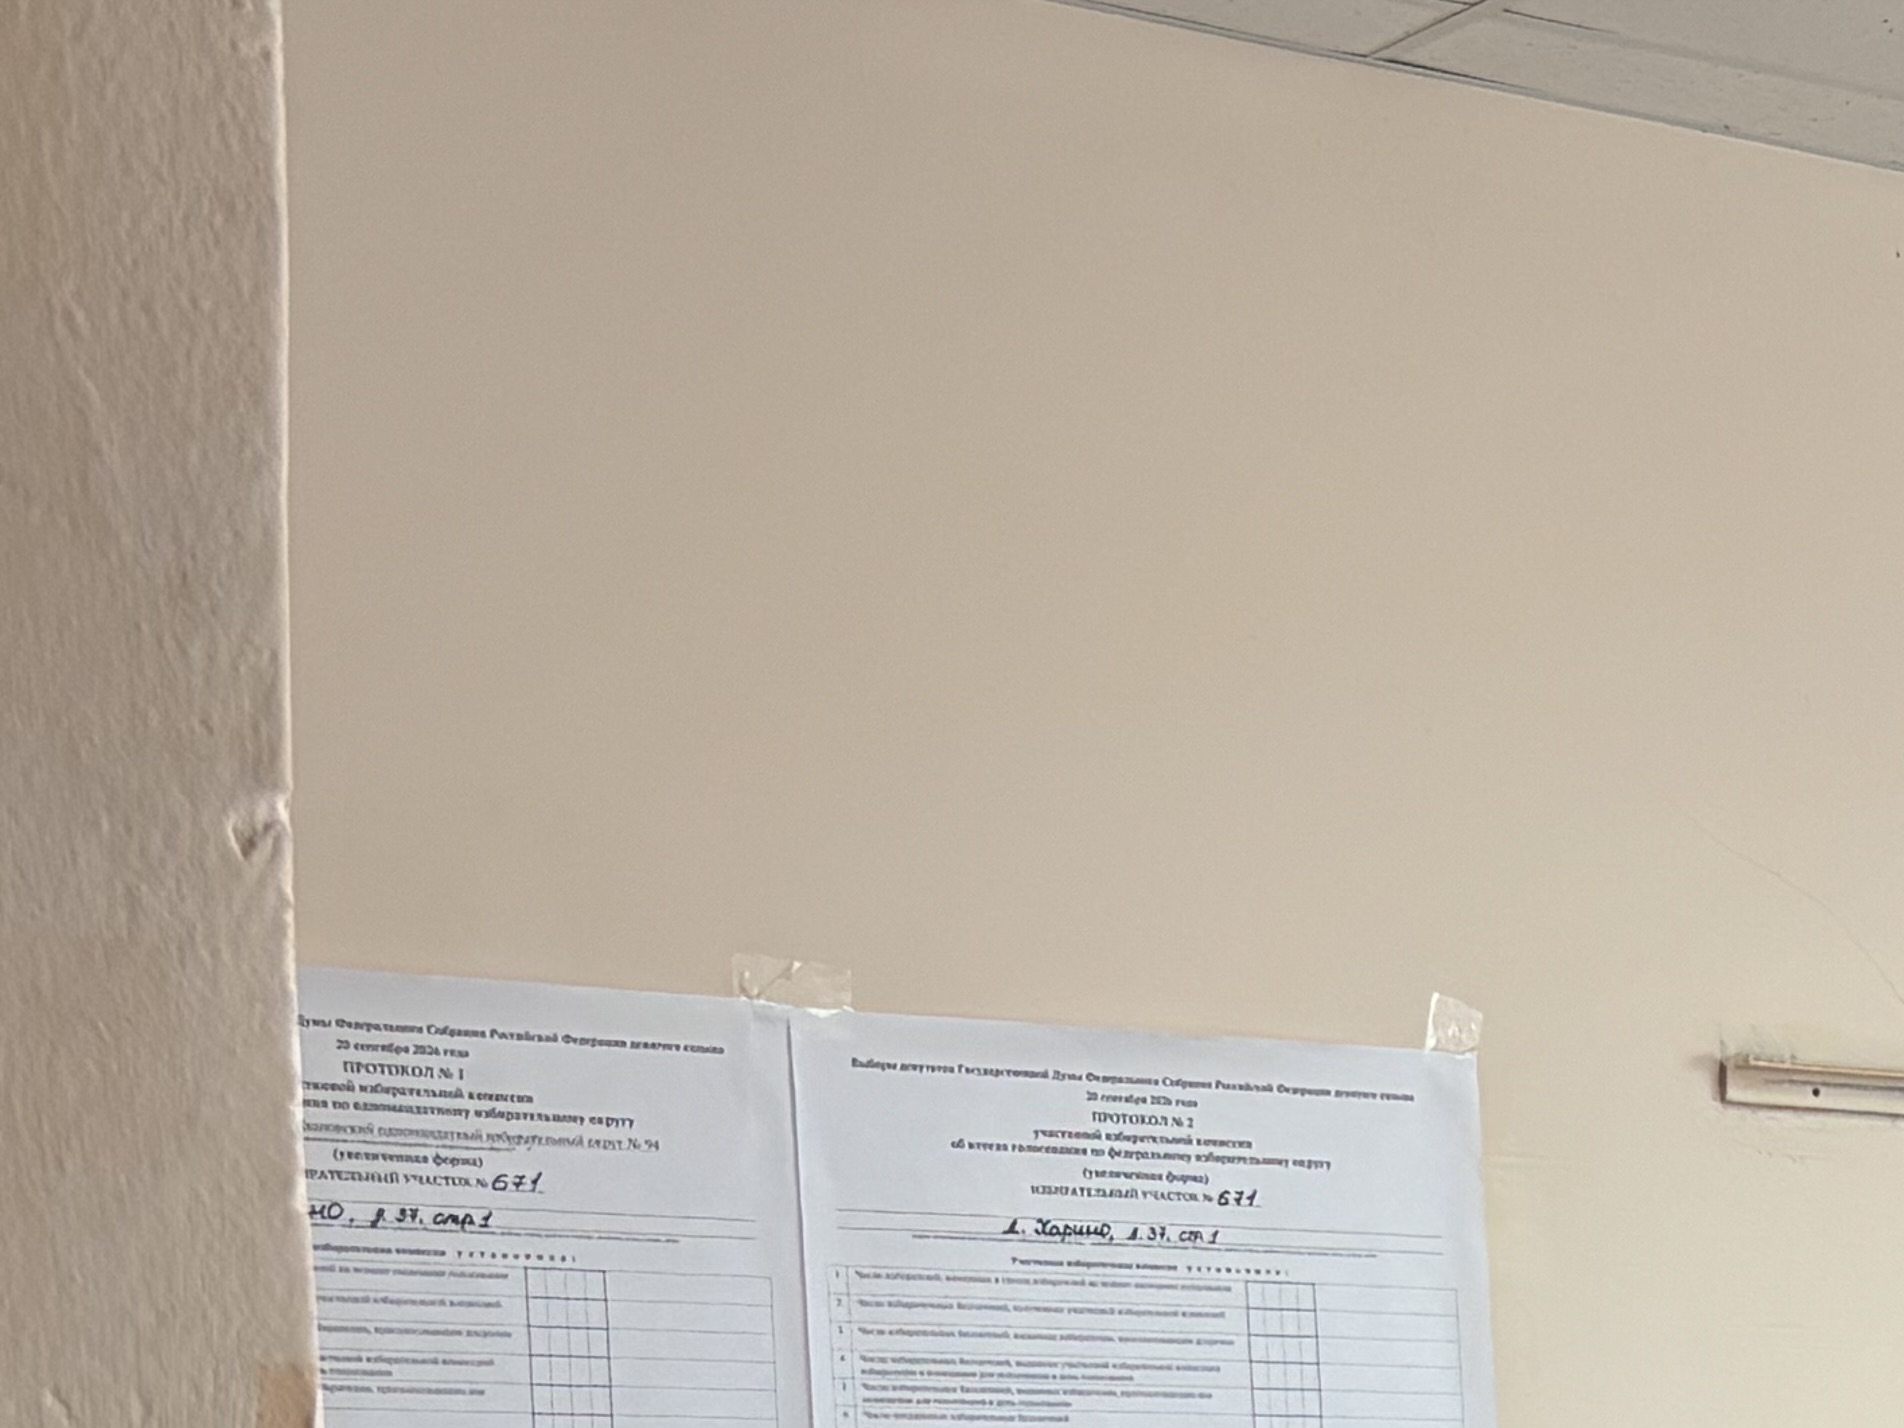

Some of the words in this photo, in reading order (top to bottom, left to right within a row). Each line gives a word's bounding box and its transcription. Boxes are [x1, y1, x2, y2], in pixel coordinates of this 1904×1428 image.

[343, 1061, 434, 1079] ПРОТОКОЛ
[1092, 1110, 1169, 1127] ПРОТОКОЛ
[491, 1171, 543, 1191] 671
[1216, 1189, 1258, 1207] 671
